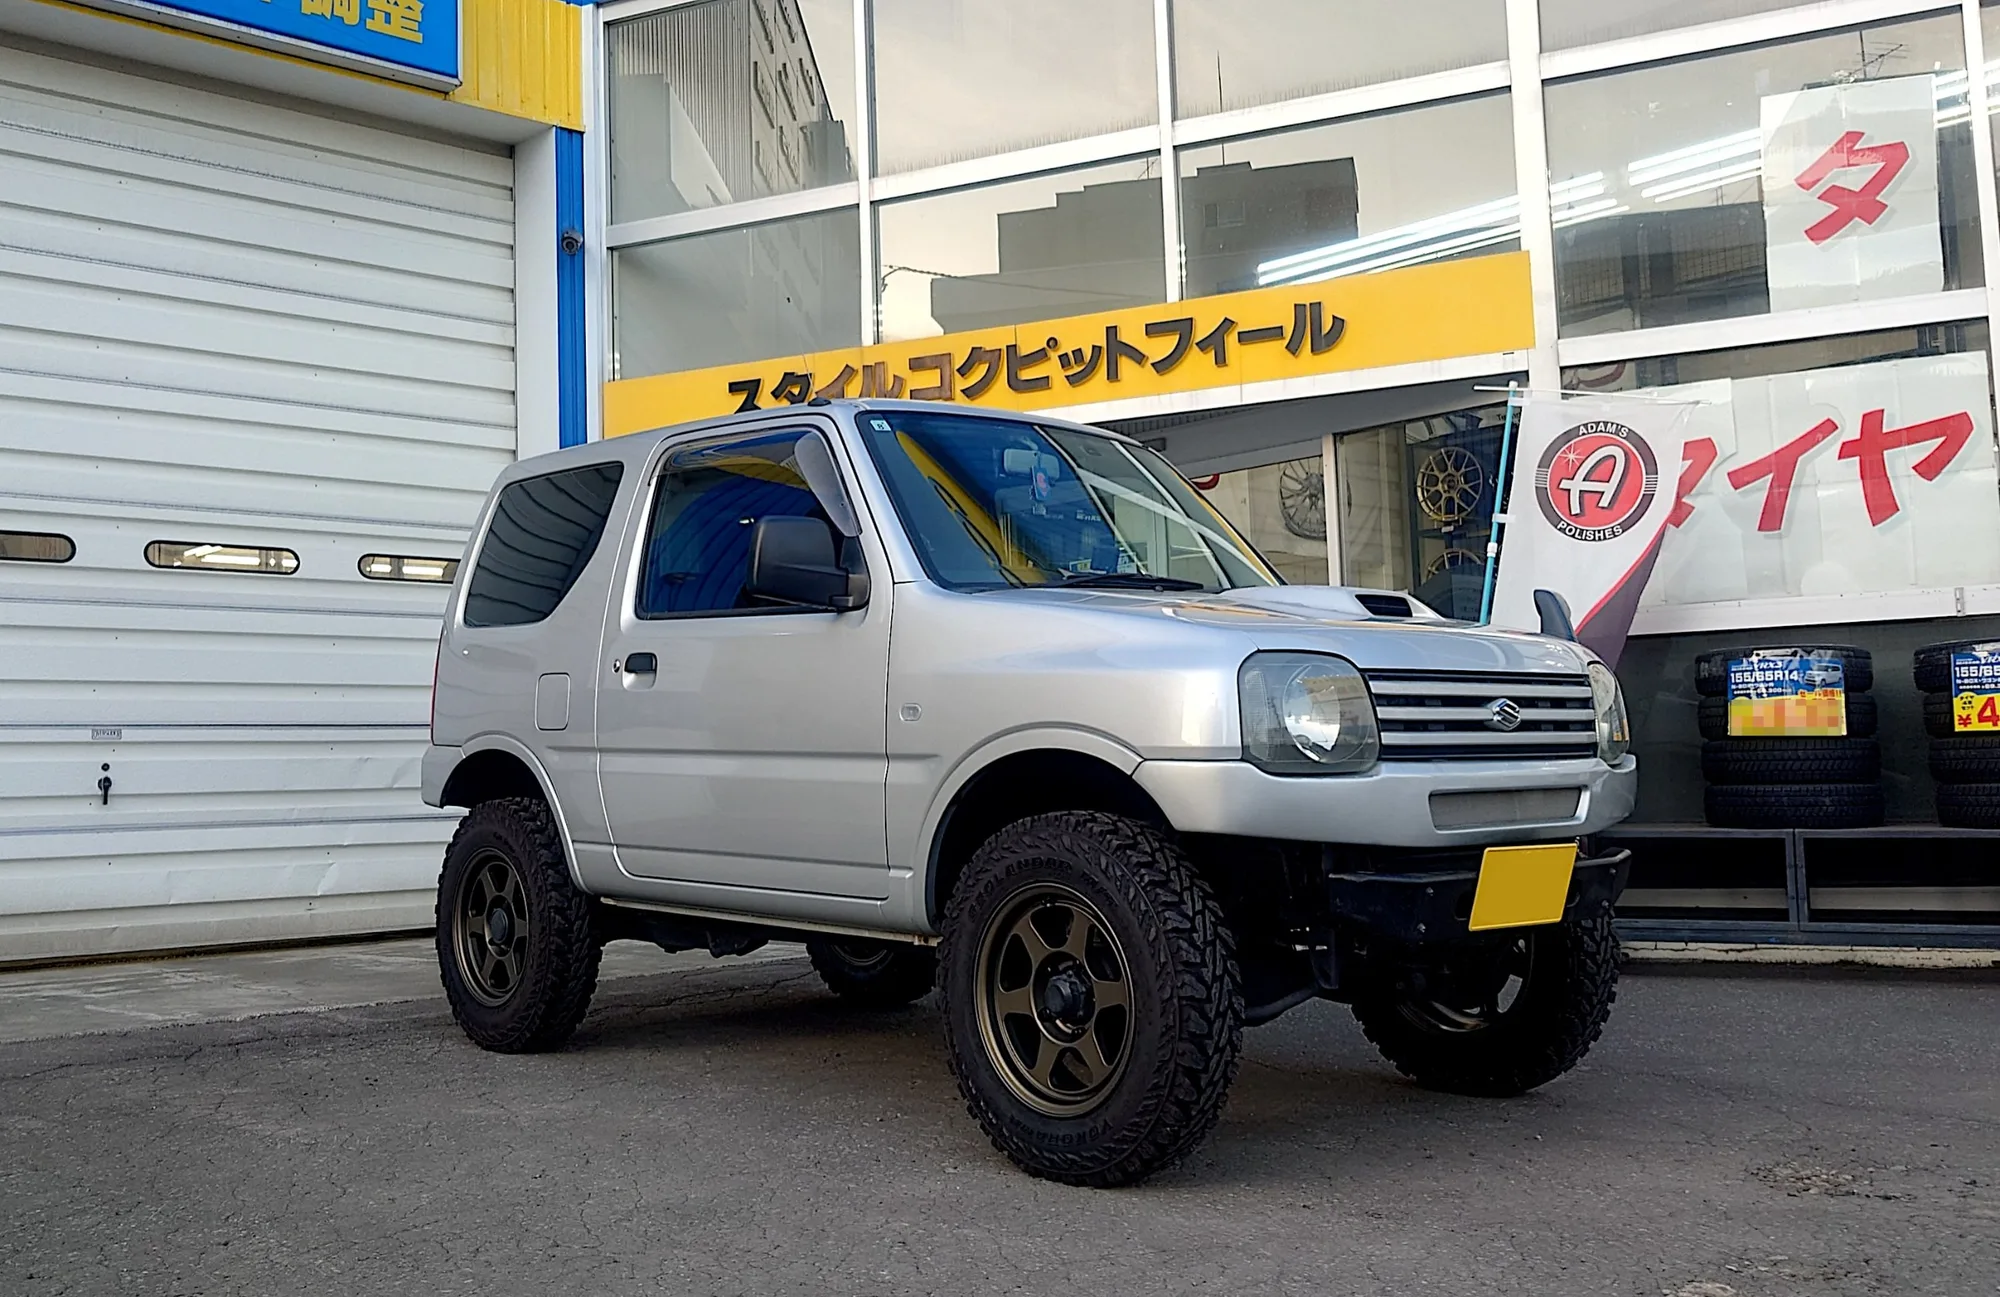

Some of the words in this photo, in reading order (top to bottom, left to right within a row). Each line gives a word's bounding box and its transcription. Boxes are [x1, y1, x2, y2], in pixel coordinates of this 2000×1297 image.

[1794, 130, 1910, 246] タ
[728, 300, 1346, 415] スタイルコクピットフィール
[1578, 421, 1630, 439] ADAM'S
[1556, 520, 1624, 542] POLISHES
[1730, 670, 1799, 684] 155/65R14
